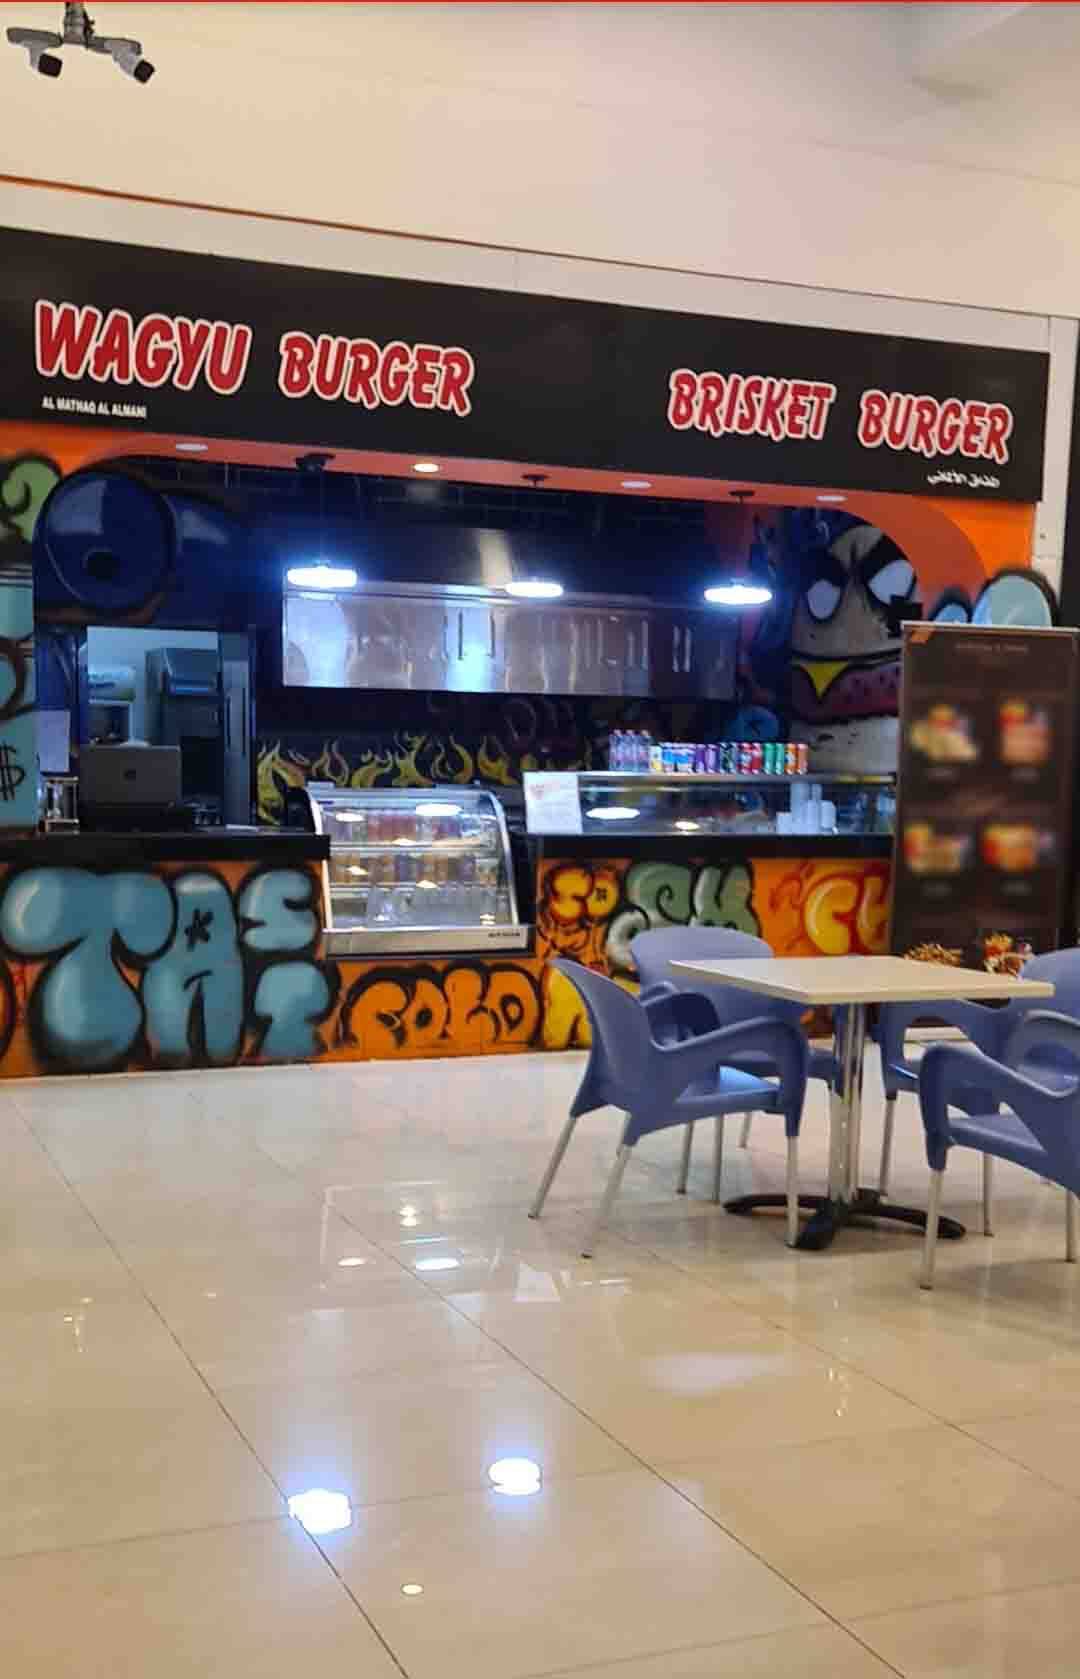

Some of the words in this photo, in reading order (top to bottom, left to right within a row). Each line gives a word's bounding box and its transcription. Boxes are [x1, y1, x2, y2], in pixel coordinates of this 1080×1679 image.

[34, 300, 252, 394] WAGYU
[278, 331, 474, 416] BURGER
[42, 395, 55, 410] AL
[667, 368, 836, 441] BRISKET
[857, 389, 1013, 464] BURGER
